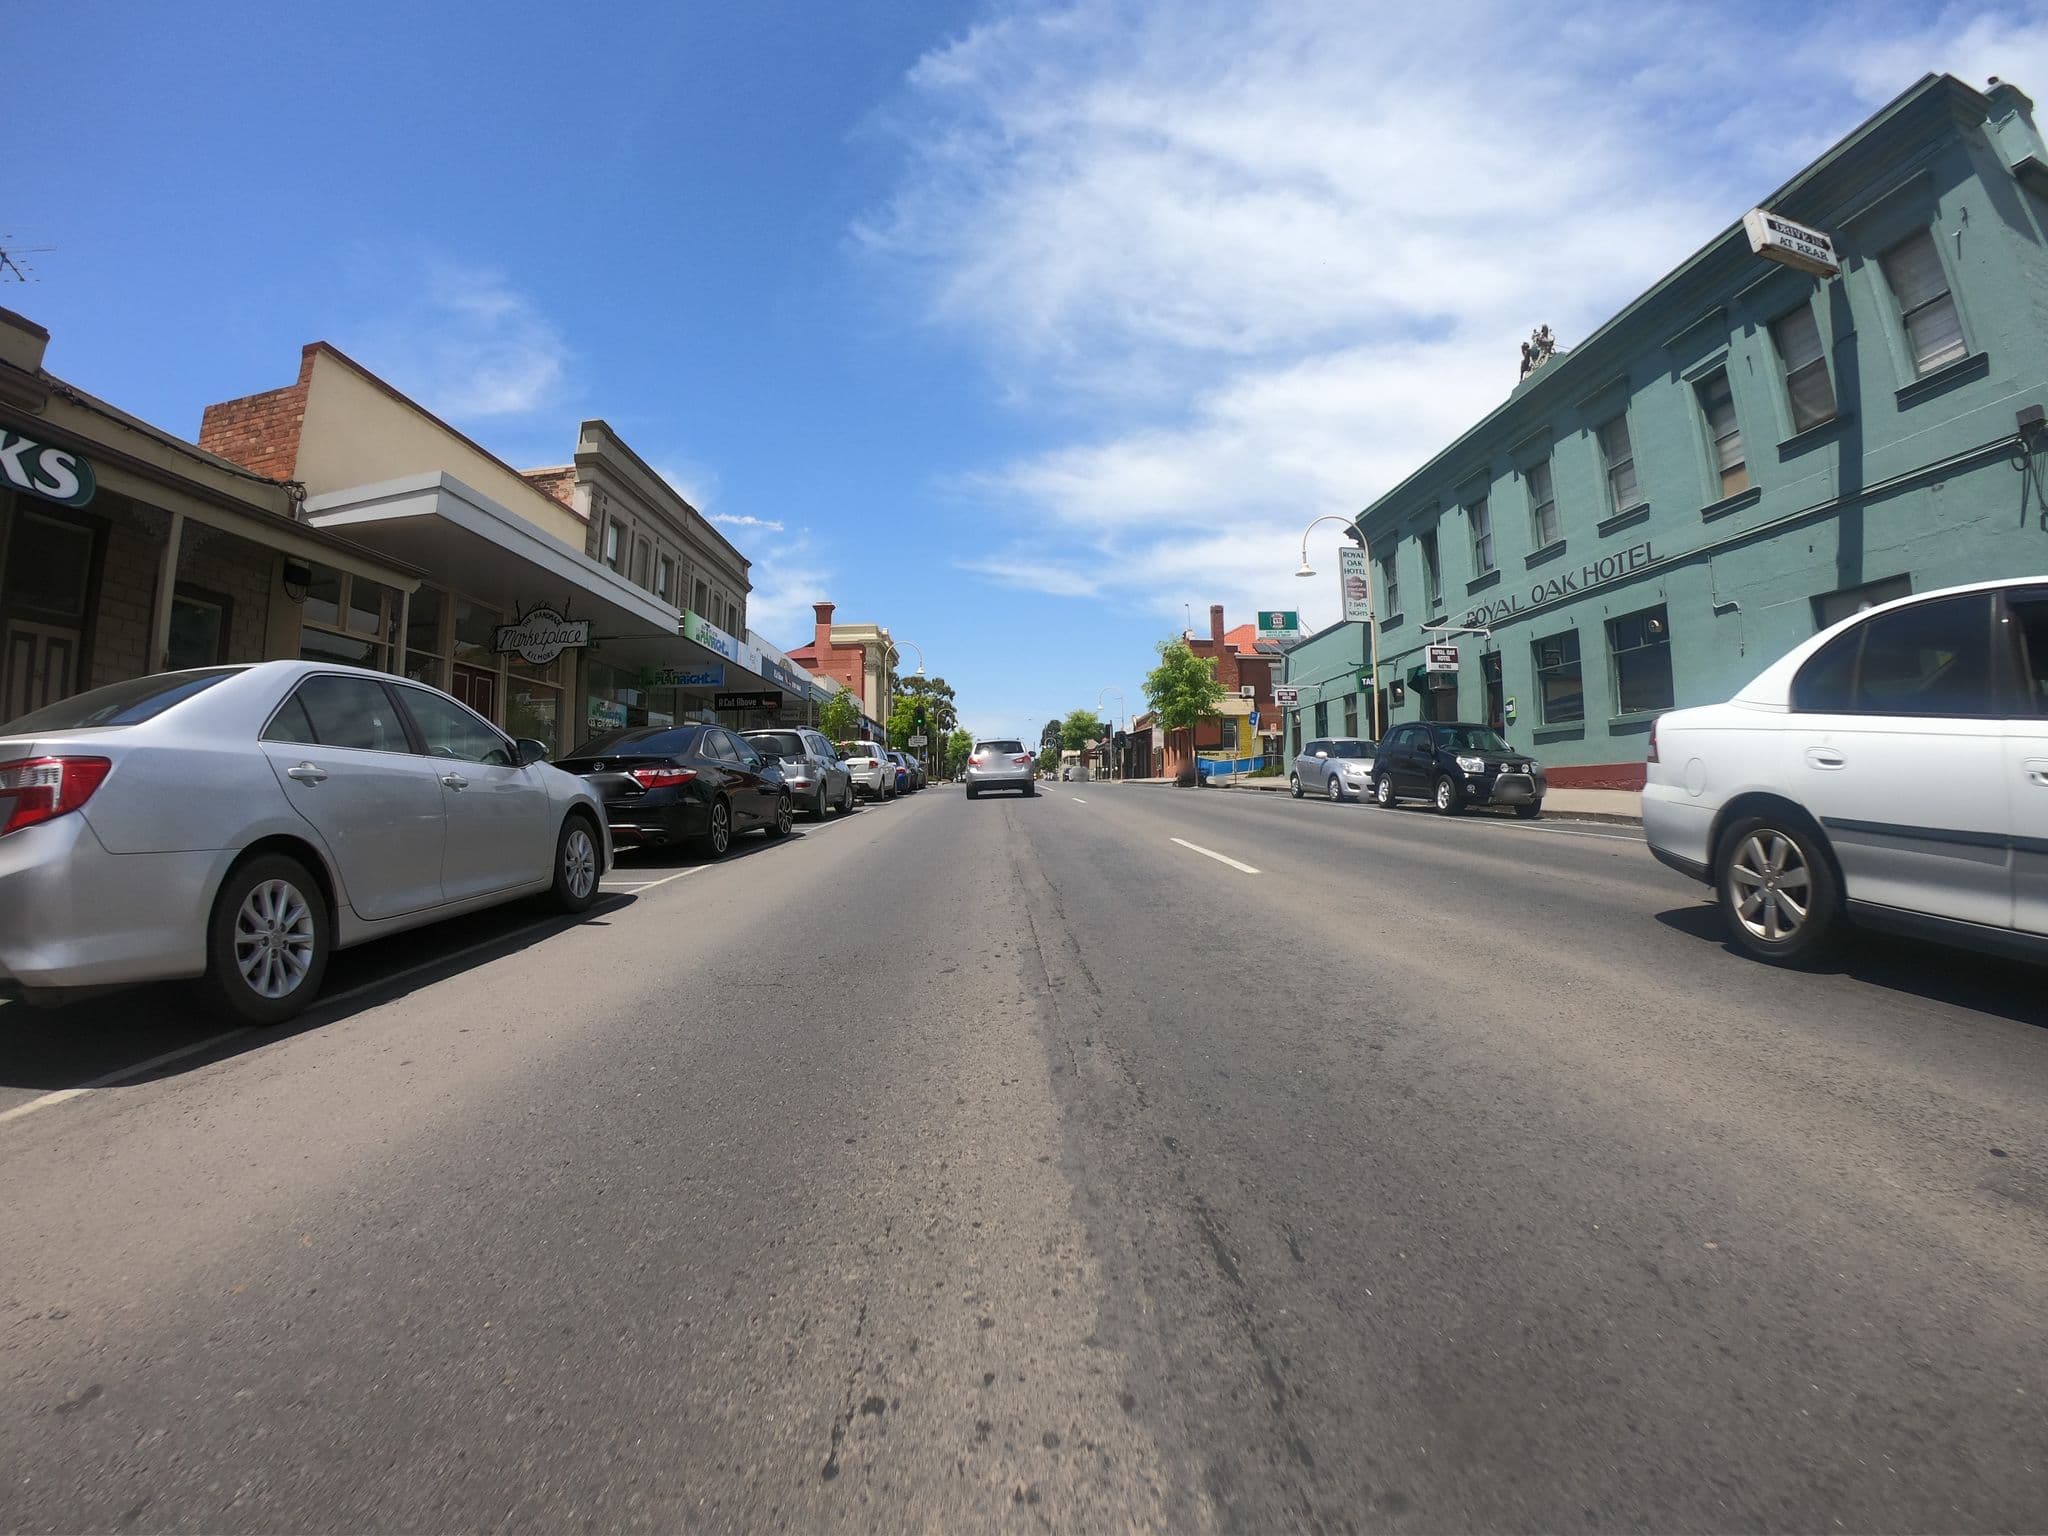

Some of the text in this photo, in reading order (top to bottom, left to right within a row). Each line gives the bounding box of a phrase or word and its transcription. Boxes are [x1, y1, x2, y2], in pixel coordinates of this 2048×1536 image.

[1780, 236, 1829, 262] AT REAR
[1343, 551, 1365, 559] ROYAL
[1466, 541, 1665, 628] ROYAL OAK HOTEL
[499, 626, 584, 653] Marketplace
[718, 698, 723, 707] A
[736, 697, 757, 707] Above
